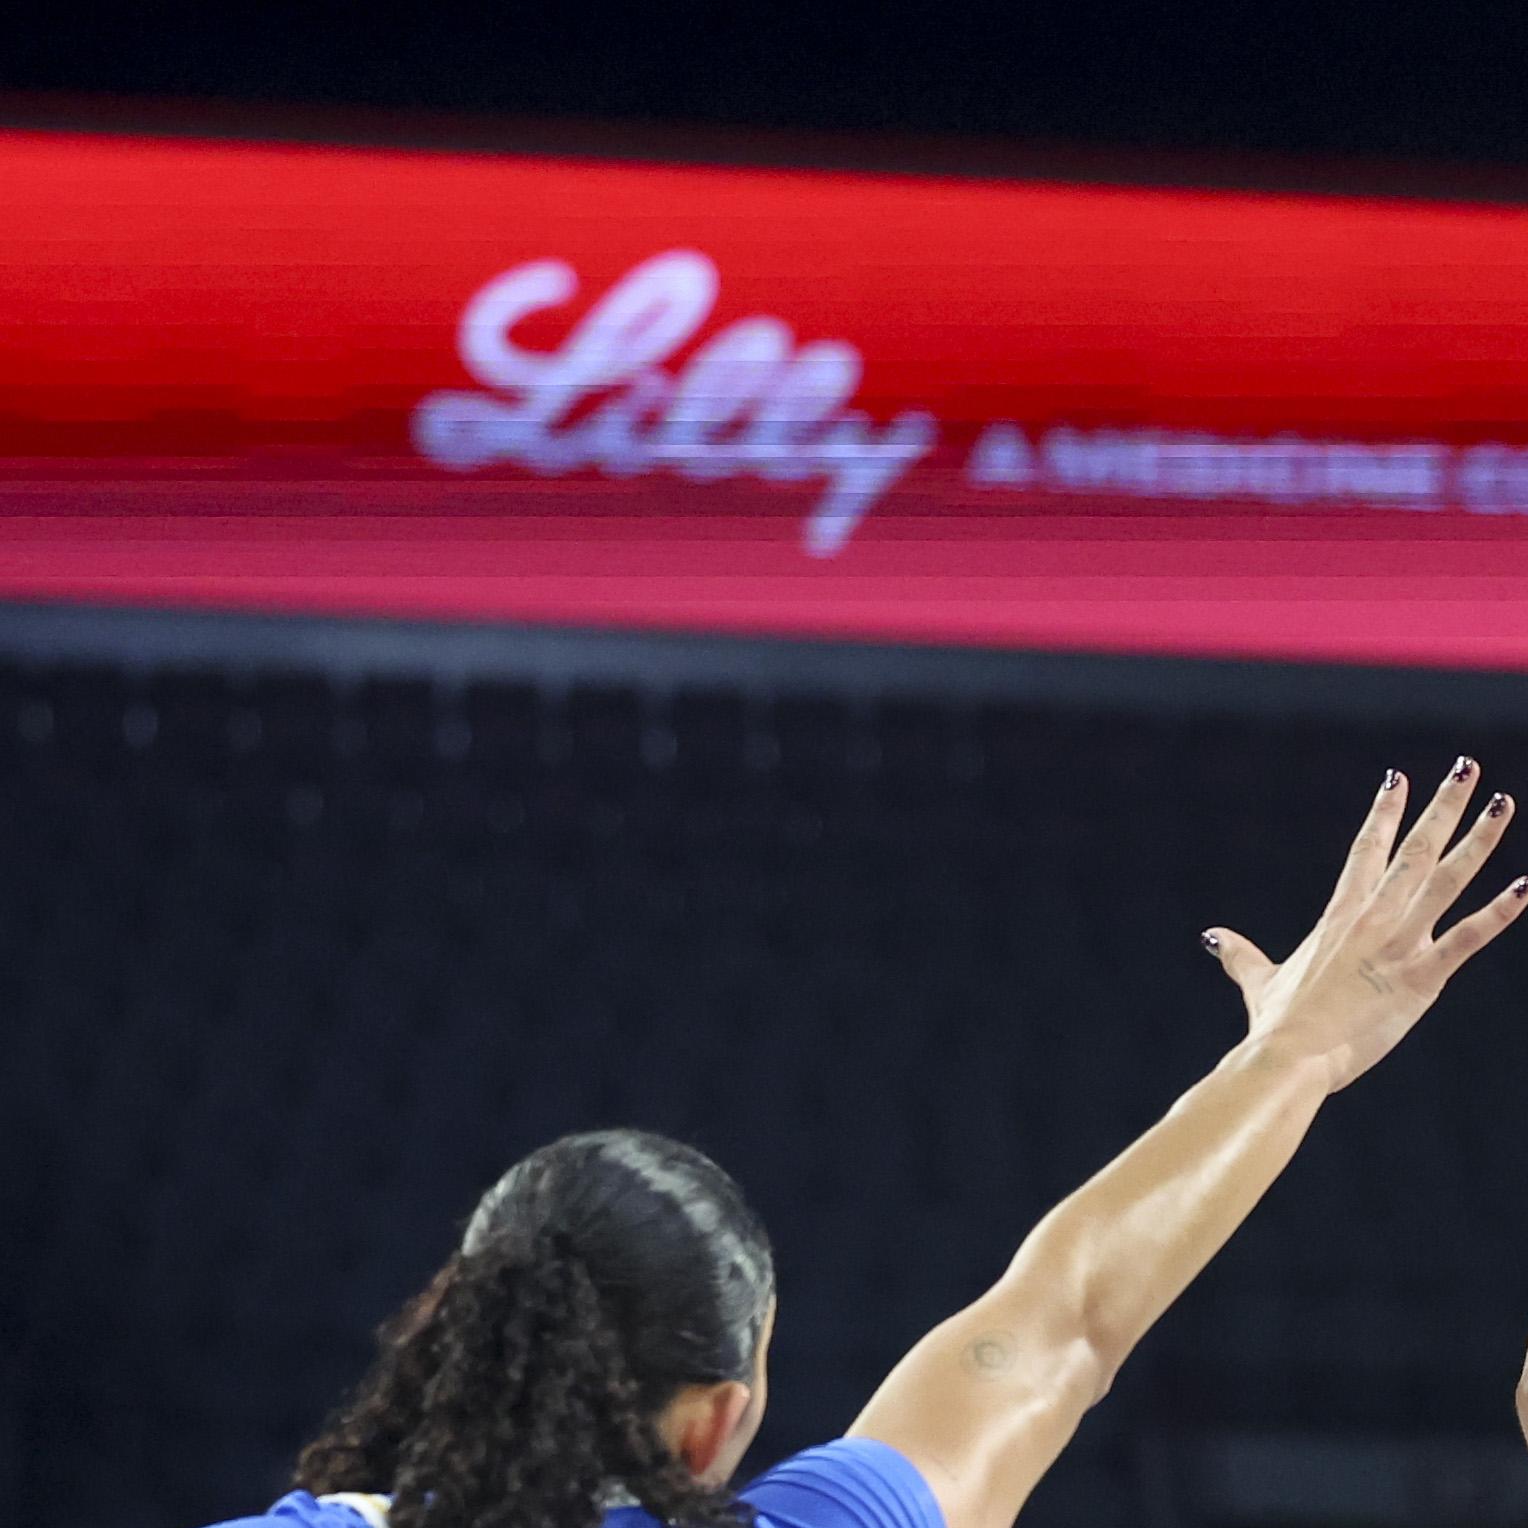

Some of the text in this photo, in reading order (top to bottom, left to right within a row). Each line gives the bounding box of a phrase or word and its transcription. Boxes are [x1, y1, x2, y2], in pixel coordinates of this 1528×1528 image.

[411, 247, 938, 559] Lilly
[968, 421, 1033, 488] A
[1039, 423, 1442, 511] MEDICINE
